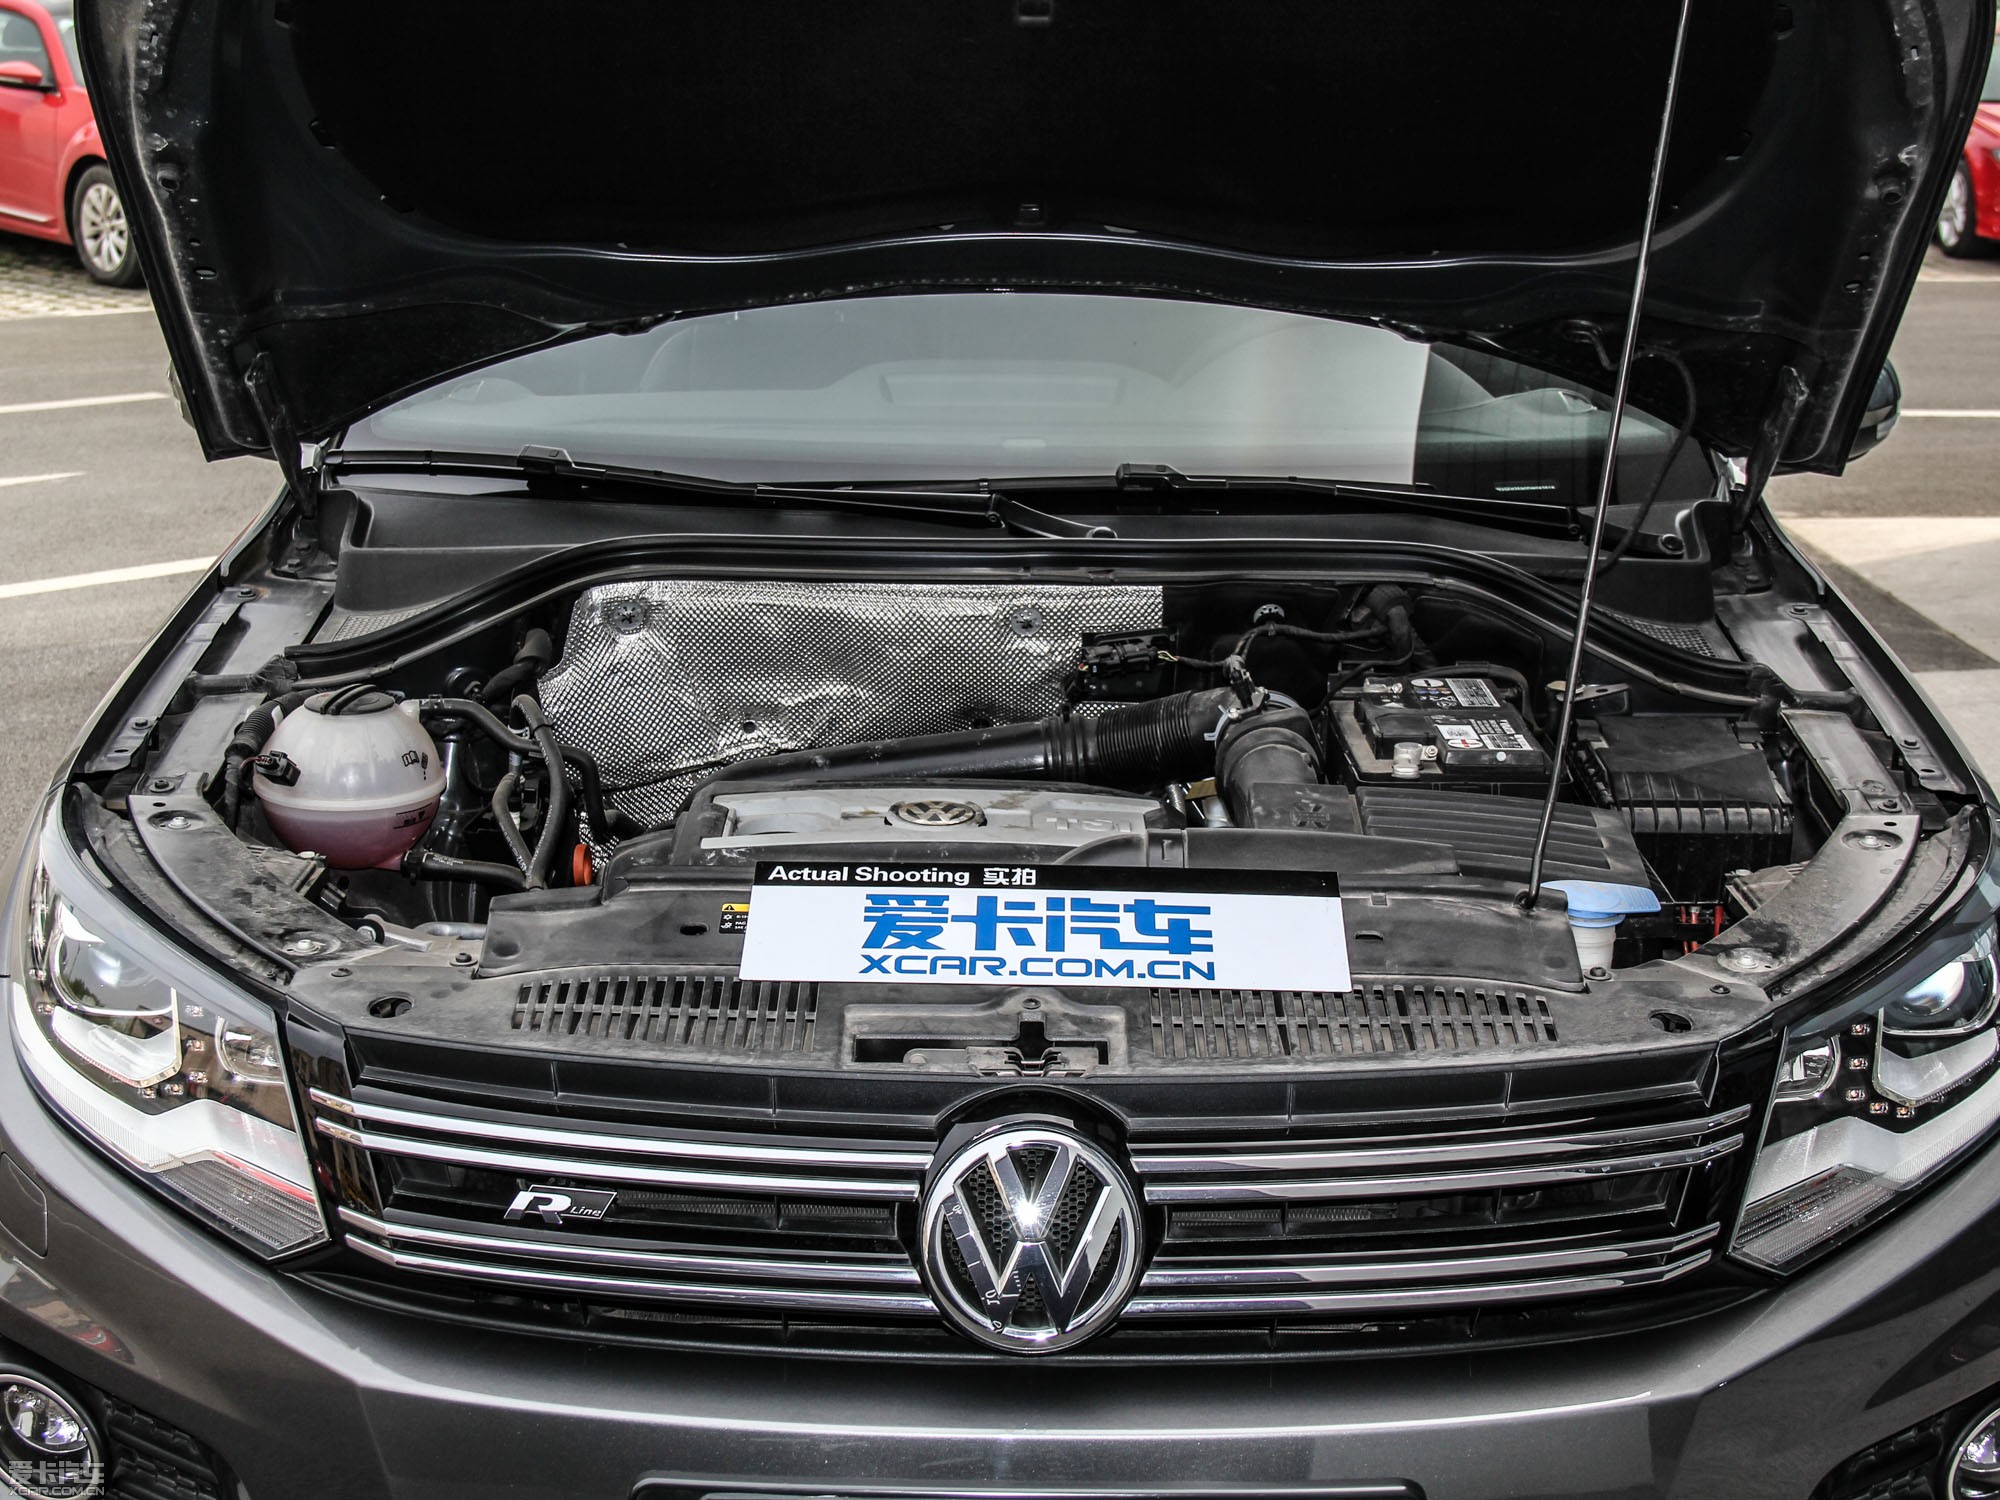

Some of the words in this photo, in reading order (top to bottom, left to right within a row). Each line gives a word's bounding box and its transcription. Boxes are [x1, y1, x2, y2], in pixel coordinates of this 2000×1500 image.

[1046, 817, 1132, 832] TSI
[767, 866, 849, 884] Actual
[854, 866, 970, 886] Shooting
[983, 867, 1037, 887] 实拍
[863, 893, 1214, 954] 爱卡汽车
[858, 954, 1216, 981] XCAR.COM.CN
[504, 1191, 563, 1224] R
[570, 1207, 602, 1217] Line
